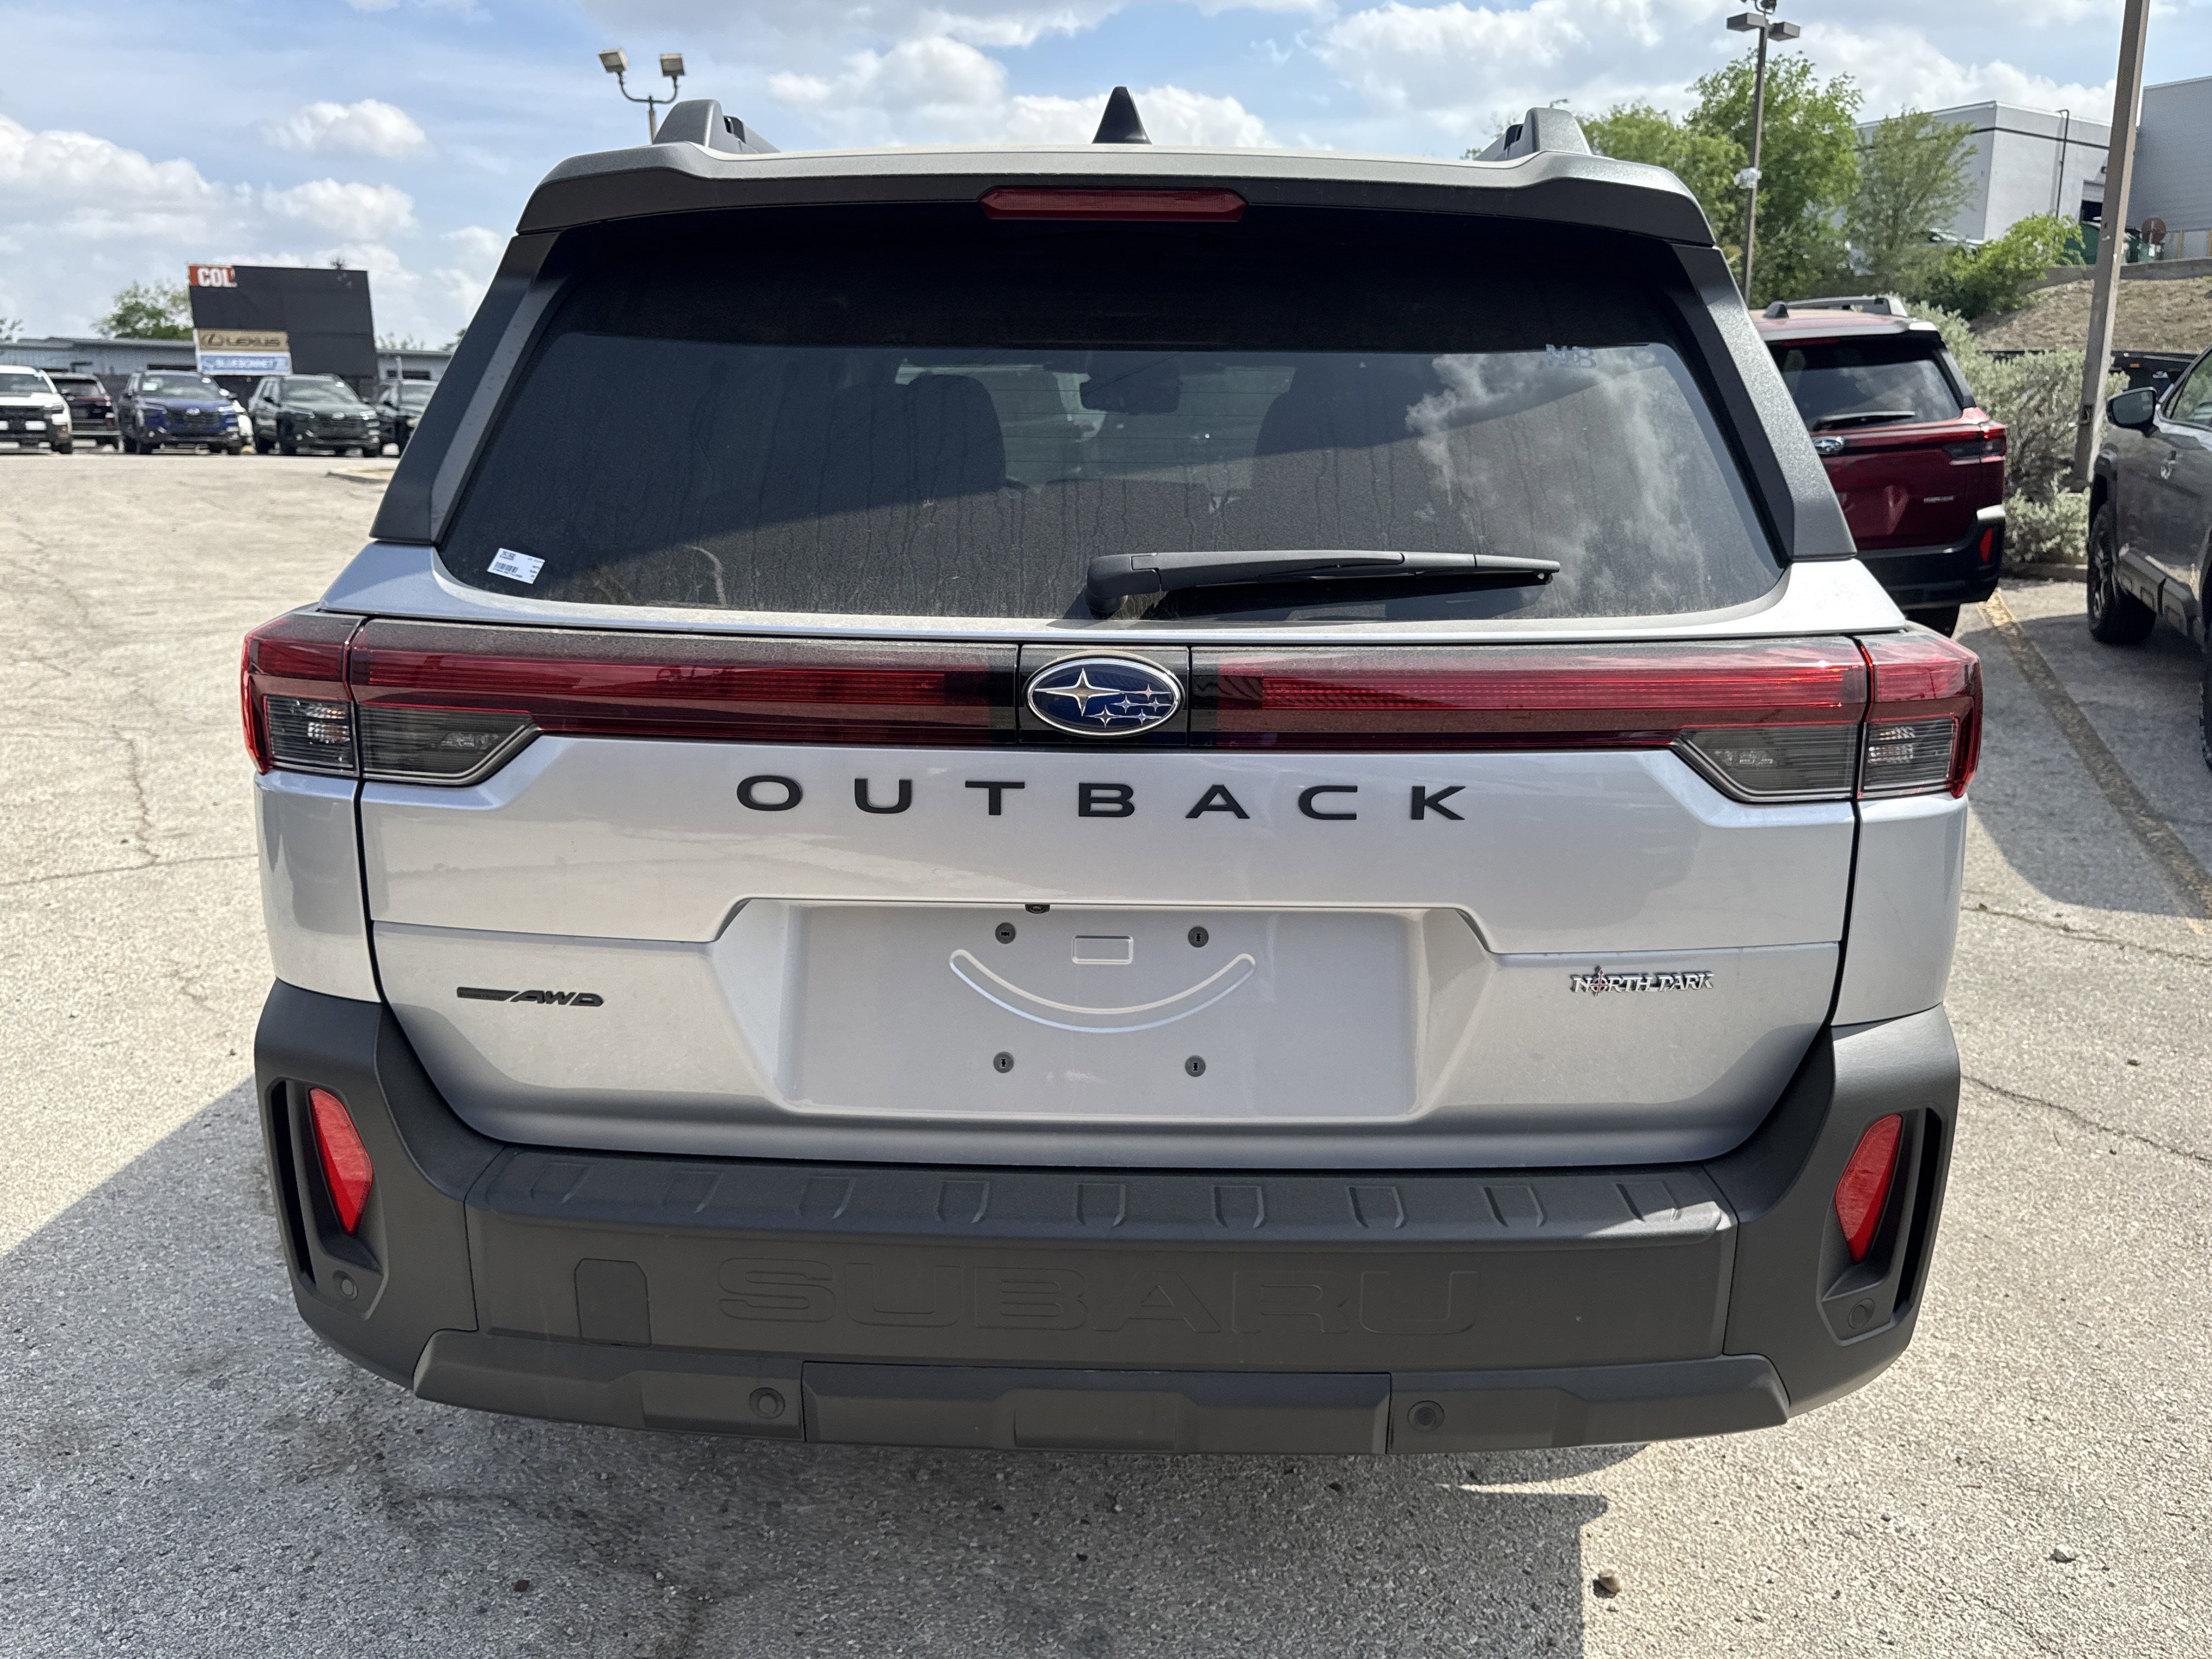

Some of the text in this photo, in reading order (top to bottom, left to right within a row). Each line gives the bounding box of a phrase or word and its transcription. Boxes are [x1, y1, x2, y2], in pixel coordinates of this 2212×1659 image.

[197, 267, 238, 287] COL
[736, 775, 1465, 821] OUTBACK
[1571, 969, 1714, 995] NORTH PARK
[510, 990, 604, 1007] AWD
[717, 1257, 1479, 1335] SUBARU
